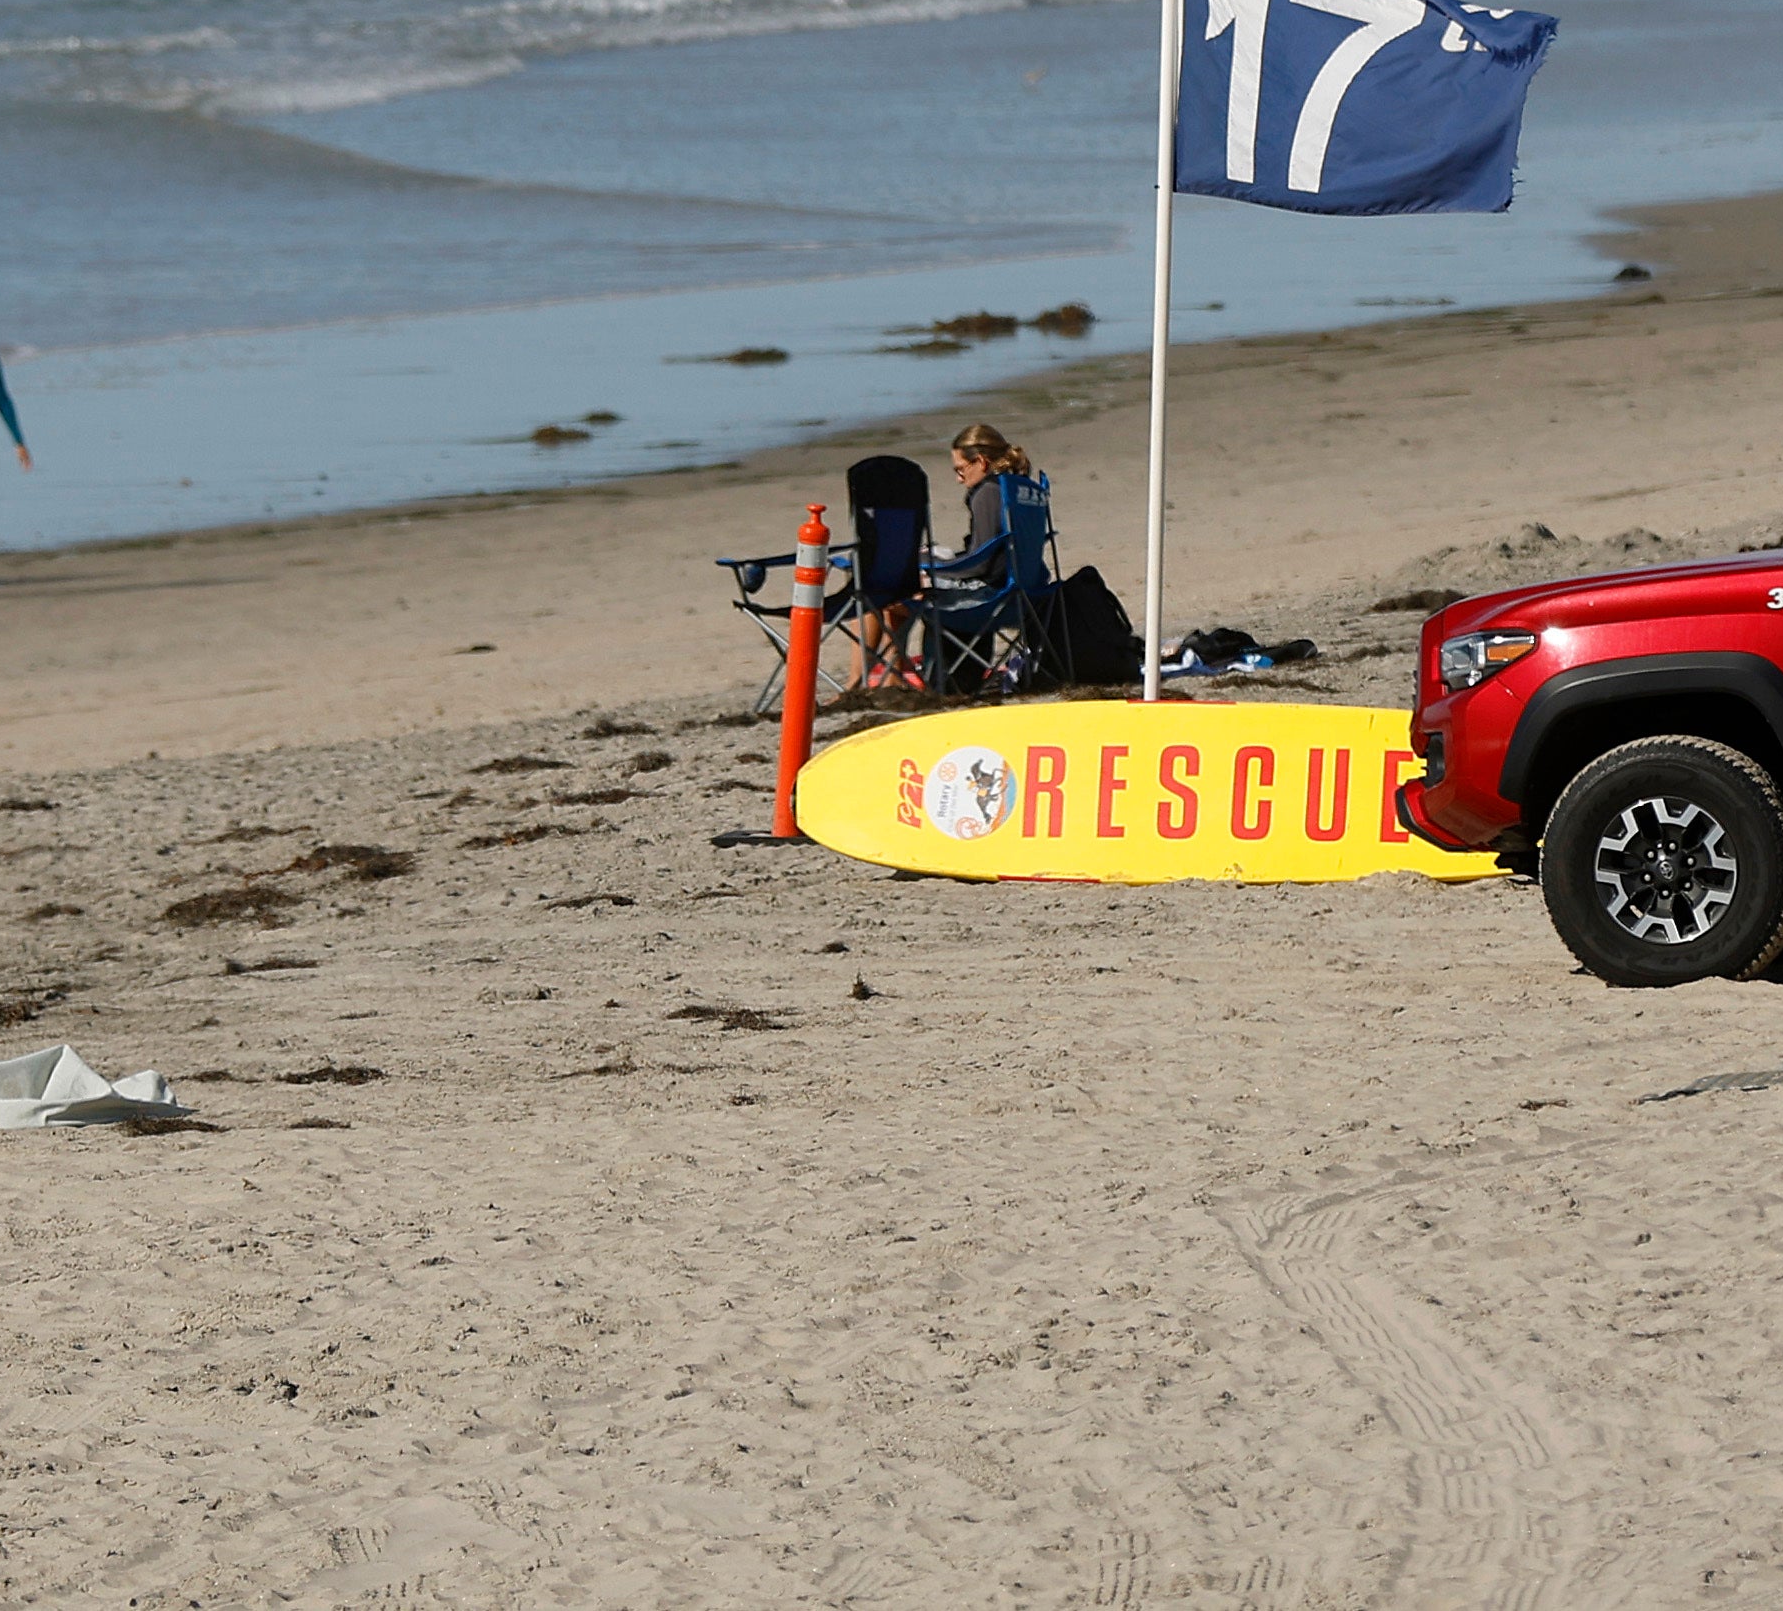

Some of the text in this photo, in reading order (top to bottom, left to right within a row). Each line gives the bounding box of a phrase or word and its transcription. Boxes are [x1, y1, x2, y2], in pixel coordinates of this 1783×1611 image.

[897, 759, 923, 829] P2P
[937, 784, 952, 817] Rotary
[1022, 745, 1413, 843] RESCUE
